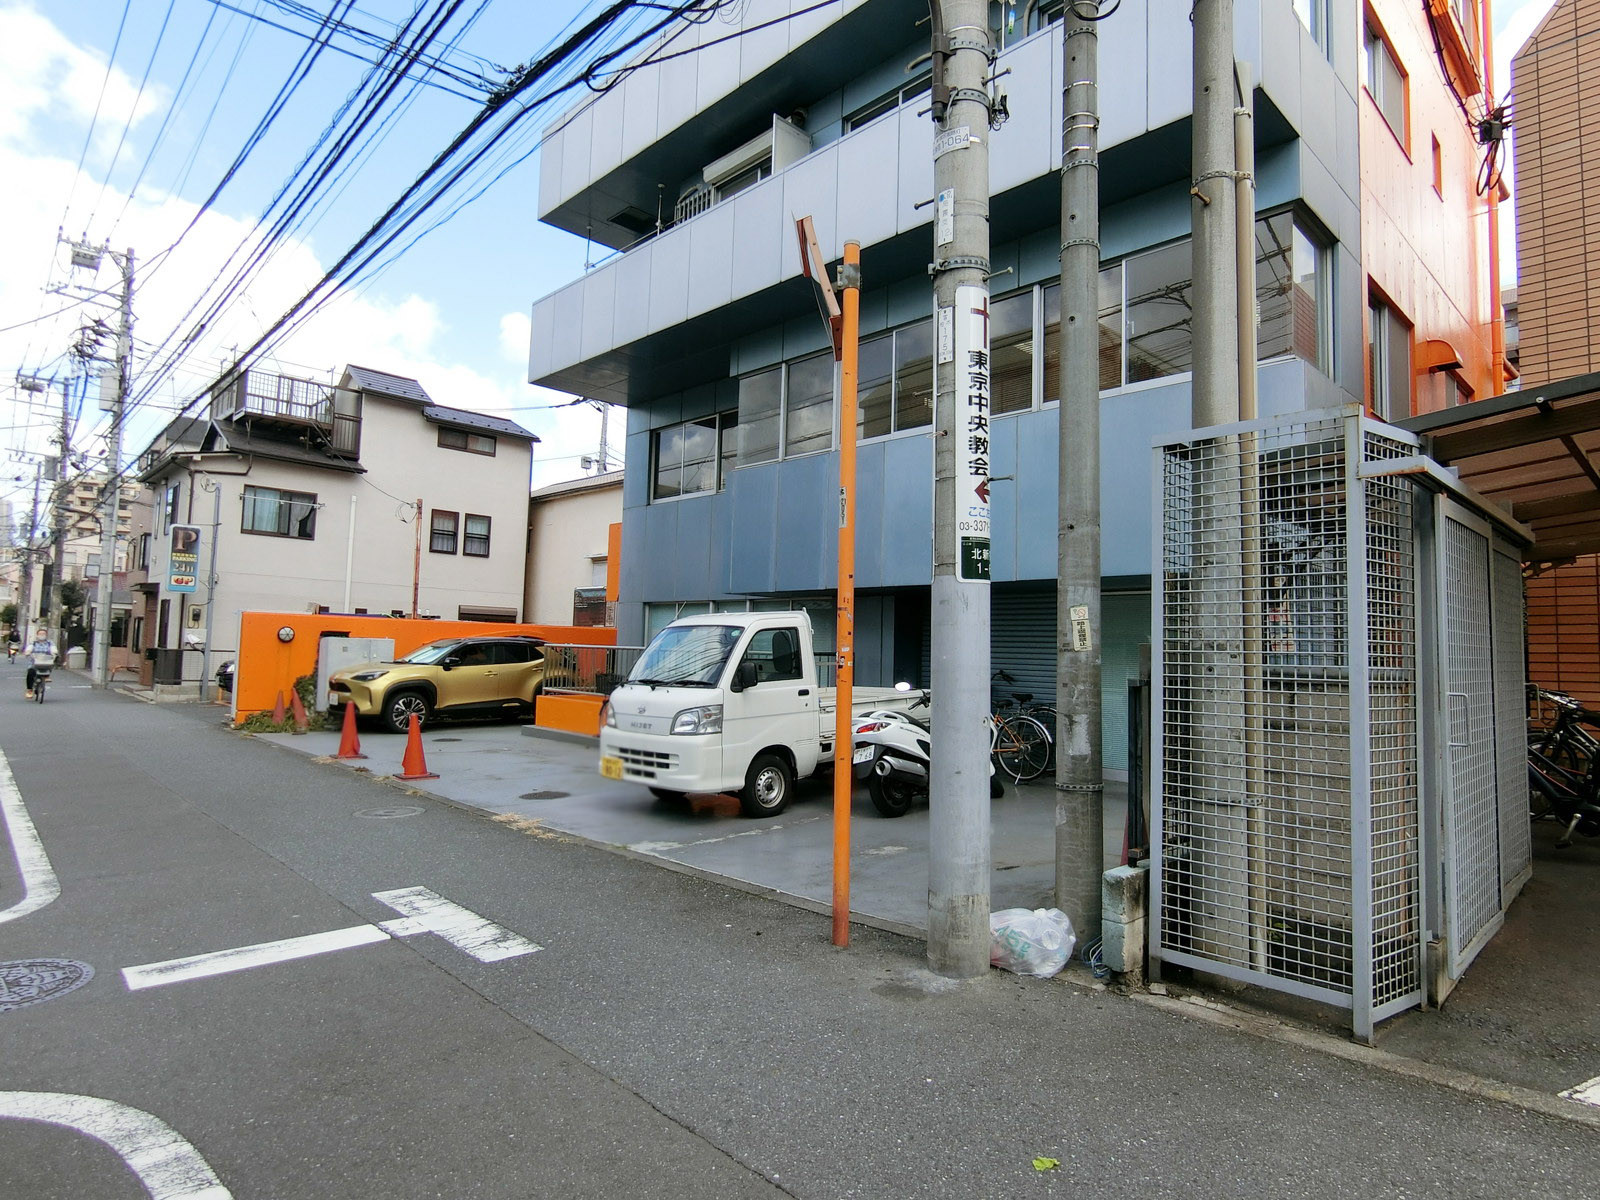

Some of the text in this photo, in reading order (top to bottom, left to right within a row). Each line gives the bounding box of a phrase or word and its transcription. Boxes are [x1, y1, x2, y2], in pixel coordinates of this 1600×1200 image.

[967, 350, 989, 476] 東京中央教会
[175, 530, 198, 549] P
